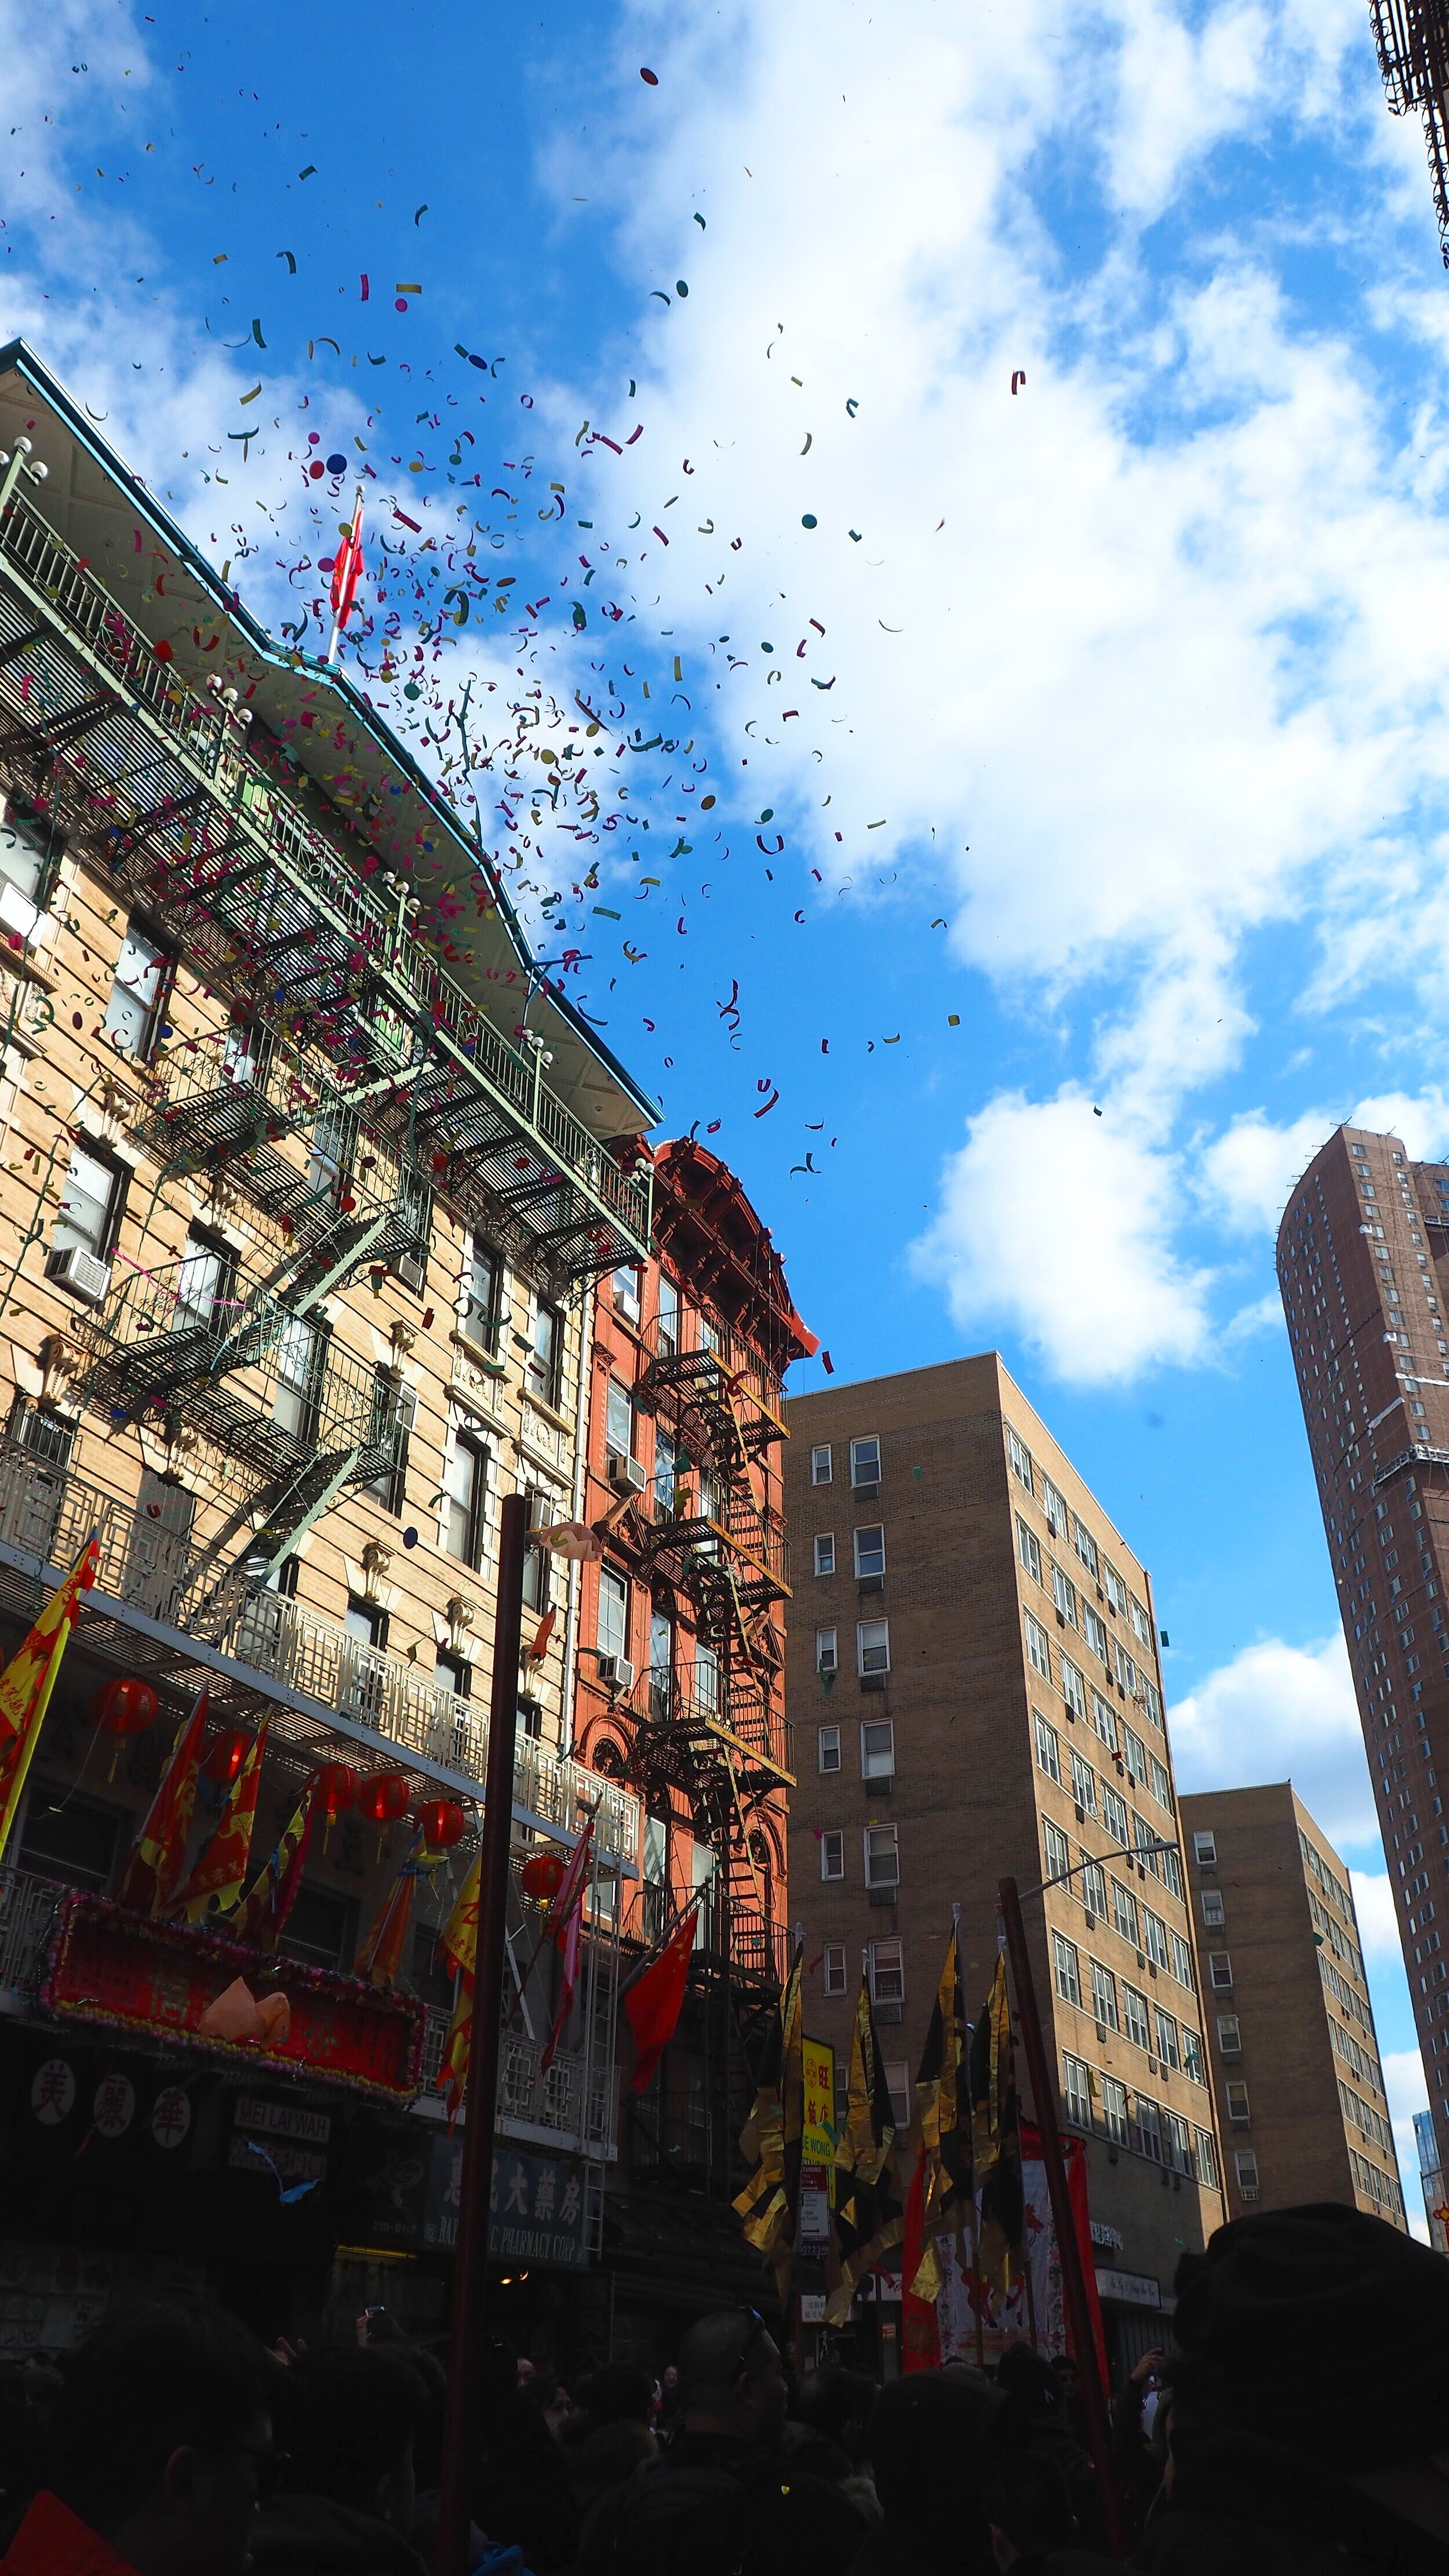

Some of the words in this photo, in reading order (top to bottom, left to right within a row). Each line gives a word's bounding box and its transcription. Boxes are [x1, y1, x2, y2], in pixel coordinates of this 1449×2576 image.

[239, 2102, 265, 2126] MEI
[268, 2106, 292, 2132] LAI
[296, 2113, 325, 2138] WAH
[811, 2138, 831, 2156] WONG
[501, 2227, 552, 2259] PHARMACY
